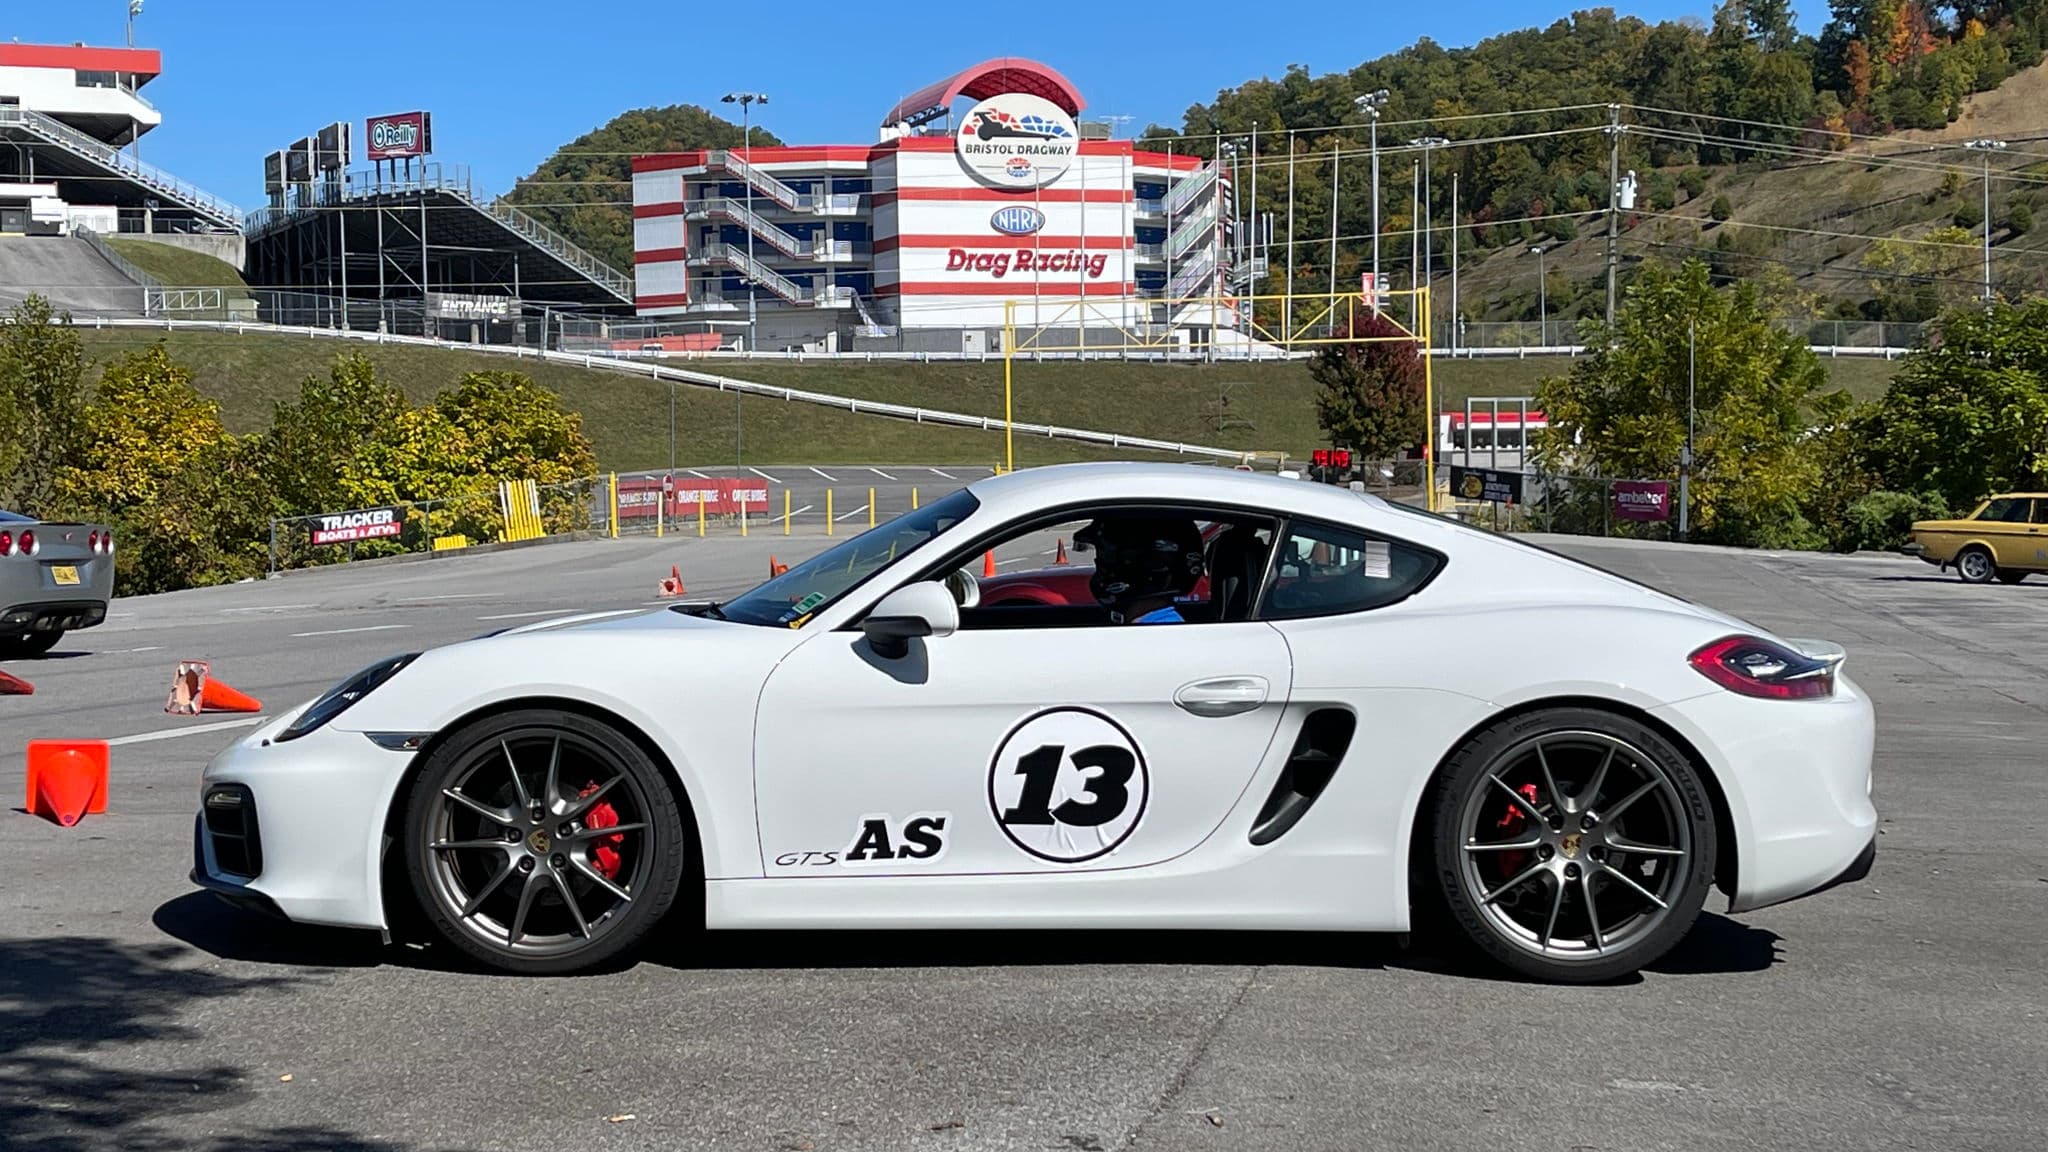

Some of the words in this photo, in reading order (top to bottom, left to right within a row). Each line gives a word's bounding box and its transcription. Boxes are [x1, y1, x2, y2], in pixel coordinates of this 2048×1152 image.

[374, 123, 416, 146] O'Reilly
[965, 144, 1013, 154] BRISTOL
[1017, 145, 1072, 155] DRAGWAY
[999, 208, 1039, 230] NHRA
[946, 249, 1012, 278] Drag
[1012, 249, 1107, 278] Racing
[441, 300, 508, 314] ENTRANCE
[321, 510, 394, 530] TRACKER
[318, 529, 357, 541] BOATS
[1003, 744, 1136, 827] 13
[846, 817, 946, 860] AS
[775, 851, 840, 866] GTS
